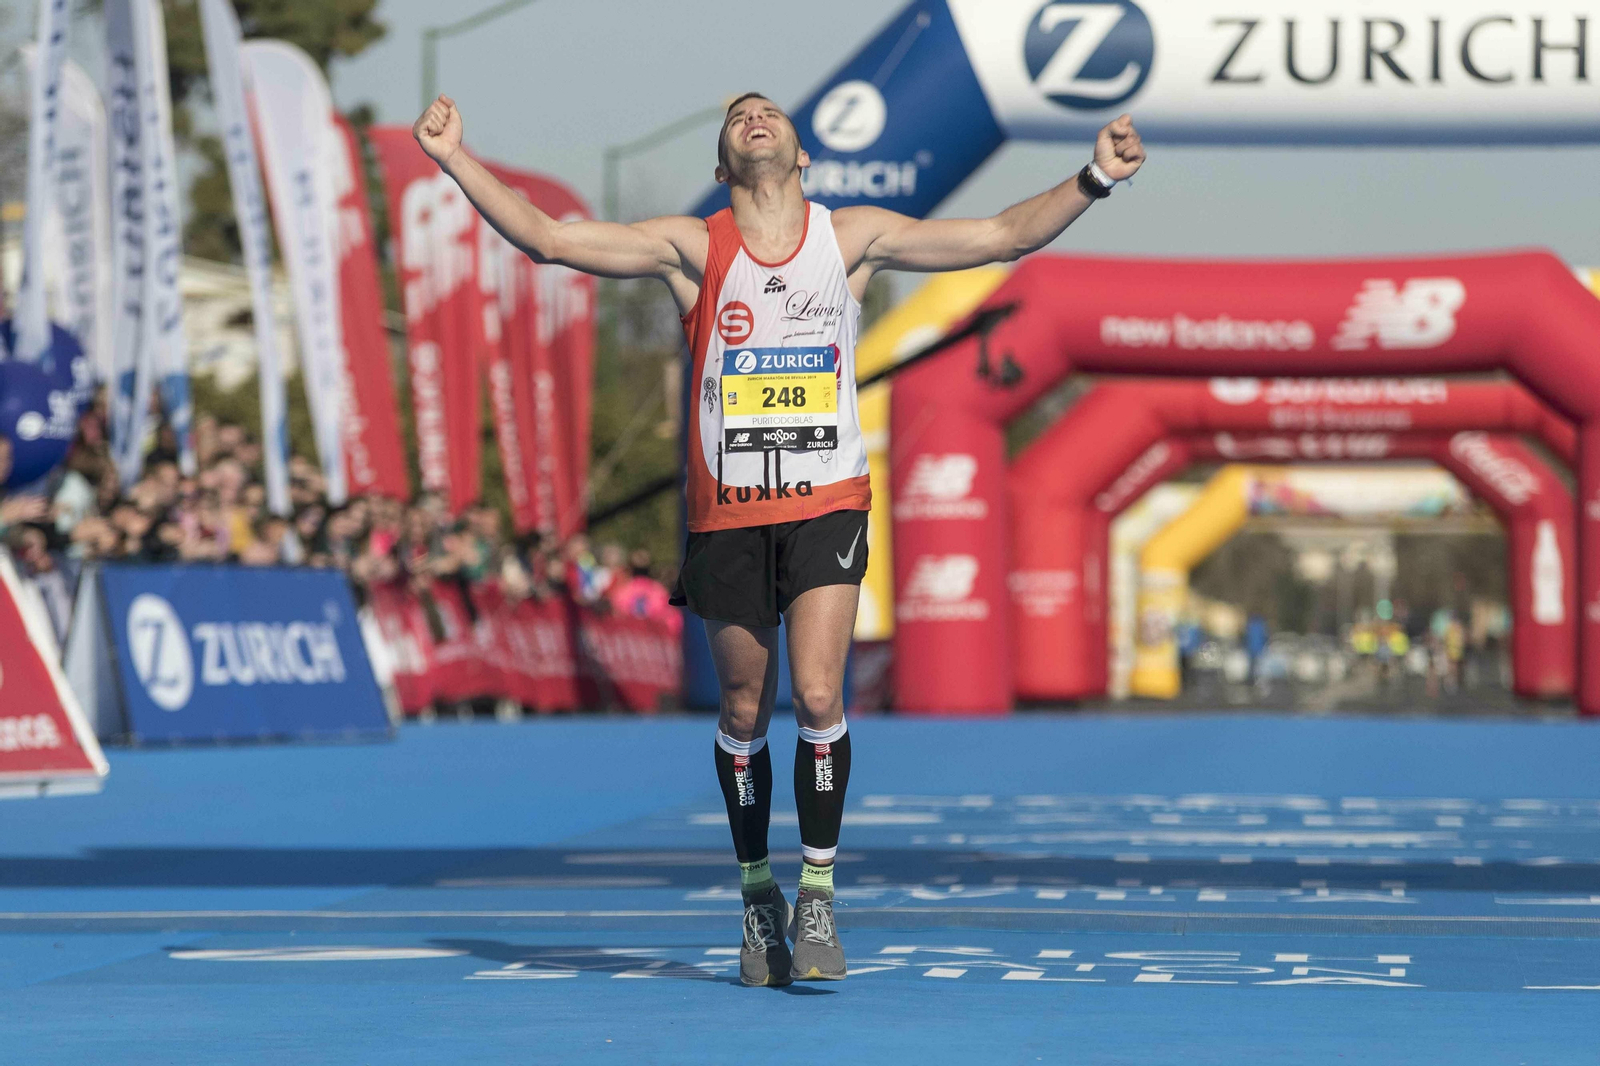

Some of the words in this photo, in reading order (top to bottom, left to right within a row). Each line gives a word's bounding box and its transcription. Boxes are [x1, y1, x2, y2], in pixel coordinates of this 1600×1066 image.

[1208, 15, 1590, 85] ZURICH
[801, 159, 918, 199] URICH
[1099, 315, 1169, 348] new
[1173, 313, 1314, 351] balance
[761, 353, 824, 368] ZURICH
[762, 386, 806, 408] 248
[752, 416, 814, 425] PURITODOBLAS
[806, 441, 834, 449] ZURICH
[192, 620, 347, 686] ZURICH
[744, 772, 755, 805] SPORT
[824, 759, 833, 791] SPORT
